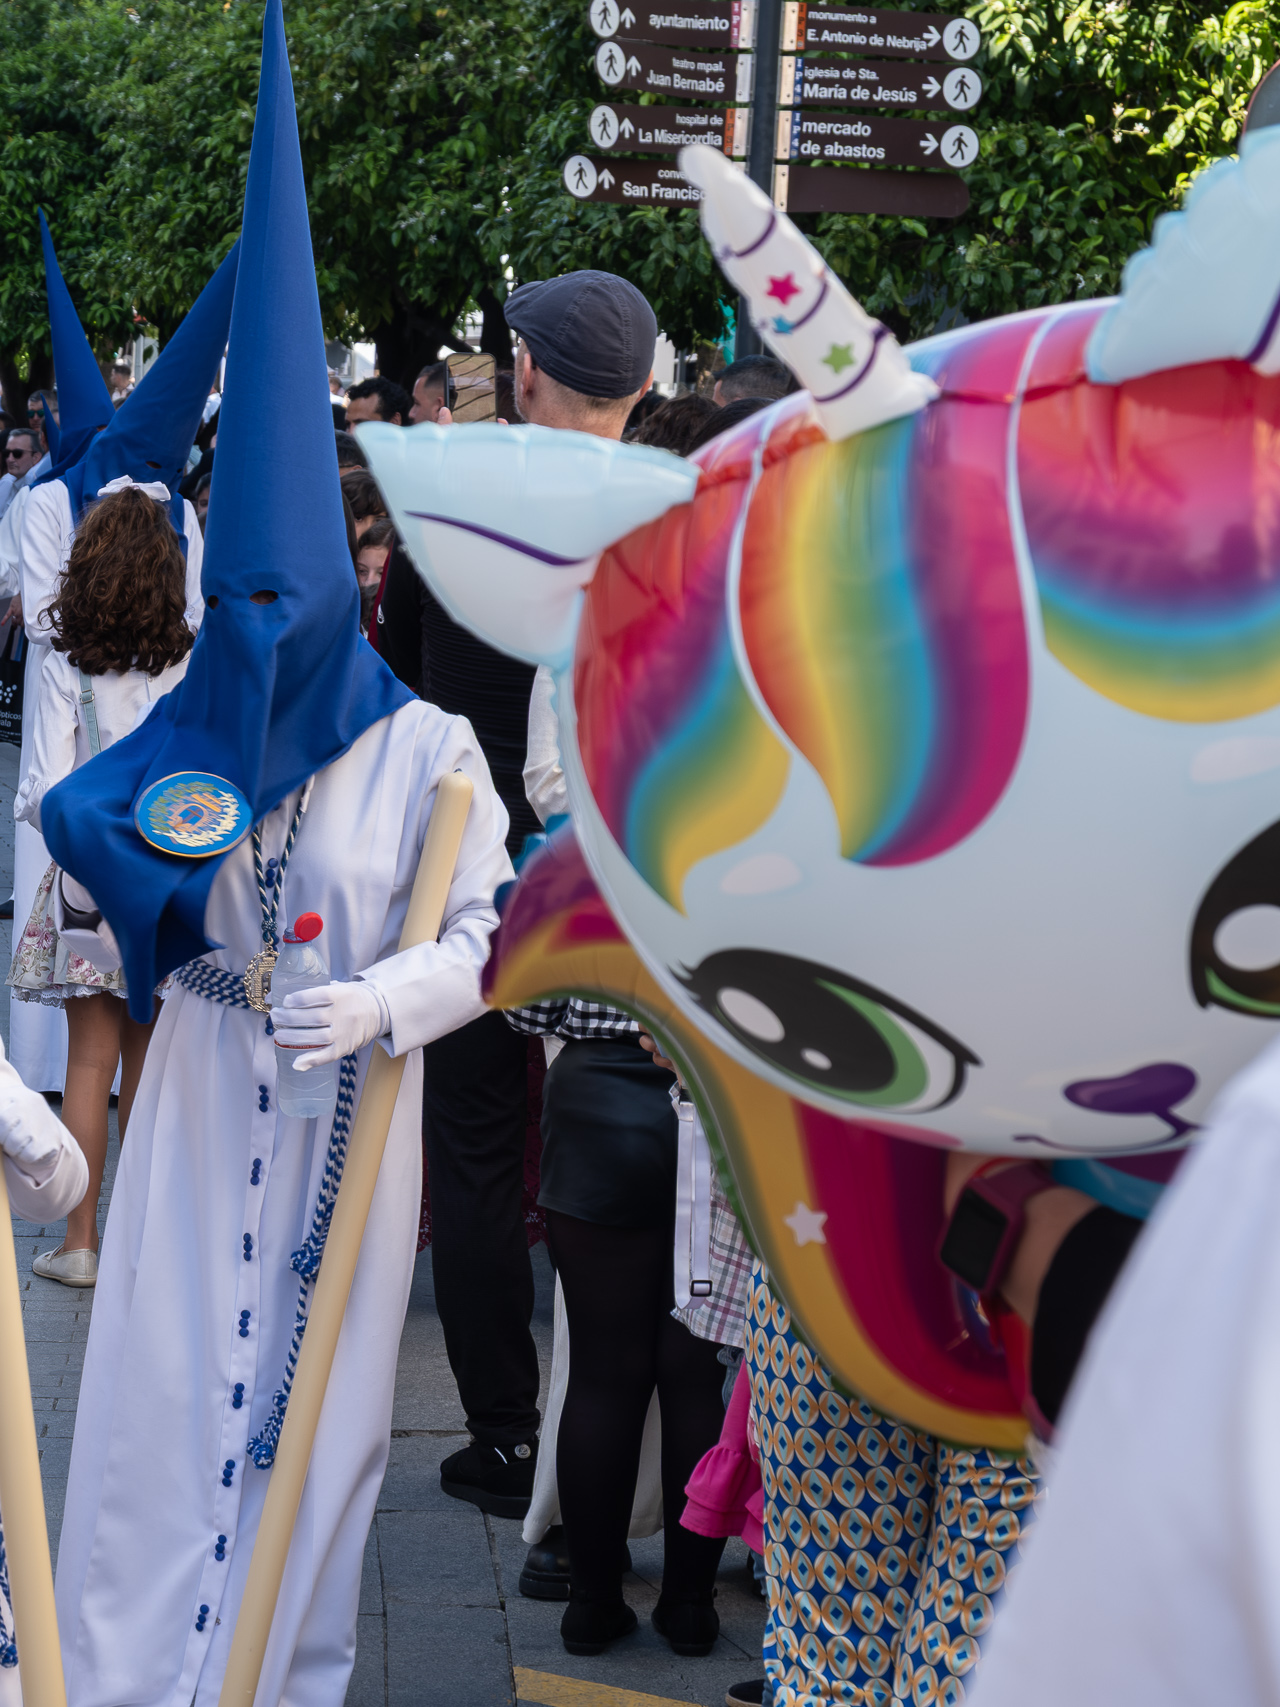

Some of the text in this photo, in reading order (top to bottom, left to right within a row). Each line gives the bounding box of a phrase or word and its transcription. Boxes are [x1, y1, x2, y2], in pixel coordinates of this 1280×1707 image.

[649, 13, 730, 32] ayuntamiento
[808, 10, 877, 24] monumento a
[806, 29, 928, 52] E. Antonio de Nebrija
[672, 57, 726, 73] teatro mpal.
[804, 66, 880, 80] iglesia de Sta.
[647, 69, 726, 93] Juan Bernabé
[803, 83, 918, 103] María de Jesús
[675, 113, 724, 127] hospital de
[802, 120, 872, 137] mercado
[638, 128, 723, 146] La Misericordia
[800, 140, 885, 159] de abastos
[657, 169, 686, 180] conve
[622, 181, 648, 198] San
